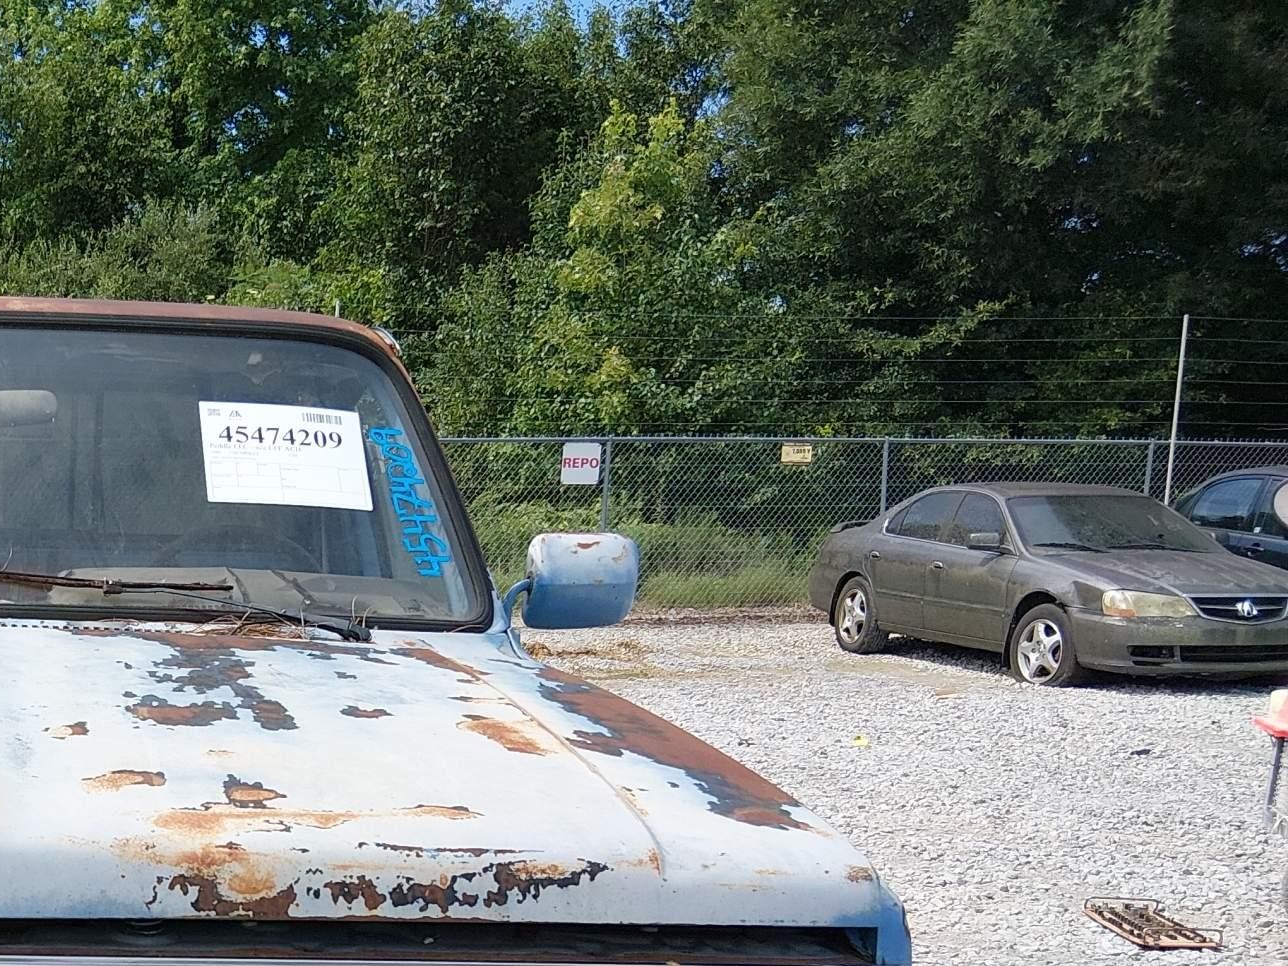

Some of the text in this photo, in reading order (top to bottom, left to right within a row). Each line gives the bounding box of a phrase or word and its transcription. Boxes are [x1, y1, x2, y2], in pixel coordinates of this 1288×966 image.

[218, 425, 342, 449] 45474209
[563, 457, 599, 469] REPO
[370, 425, 451, 578] 45474209
